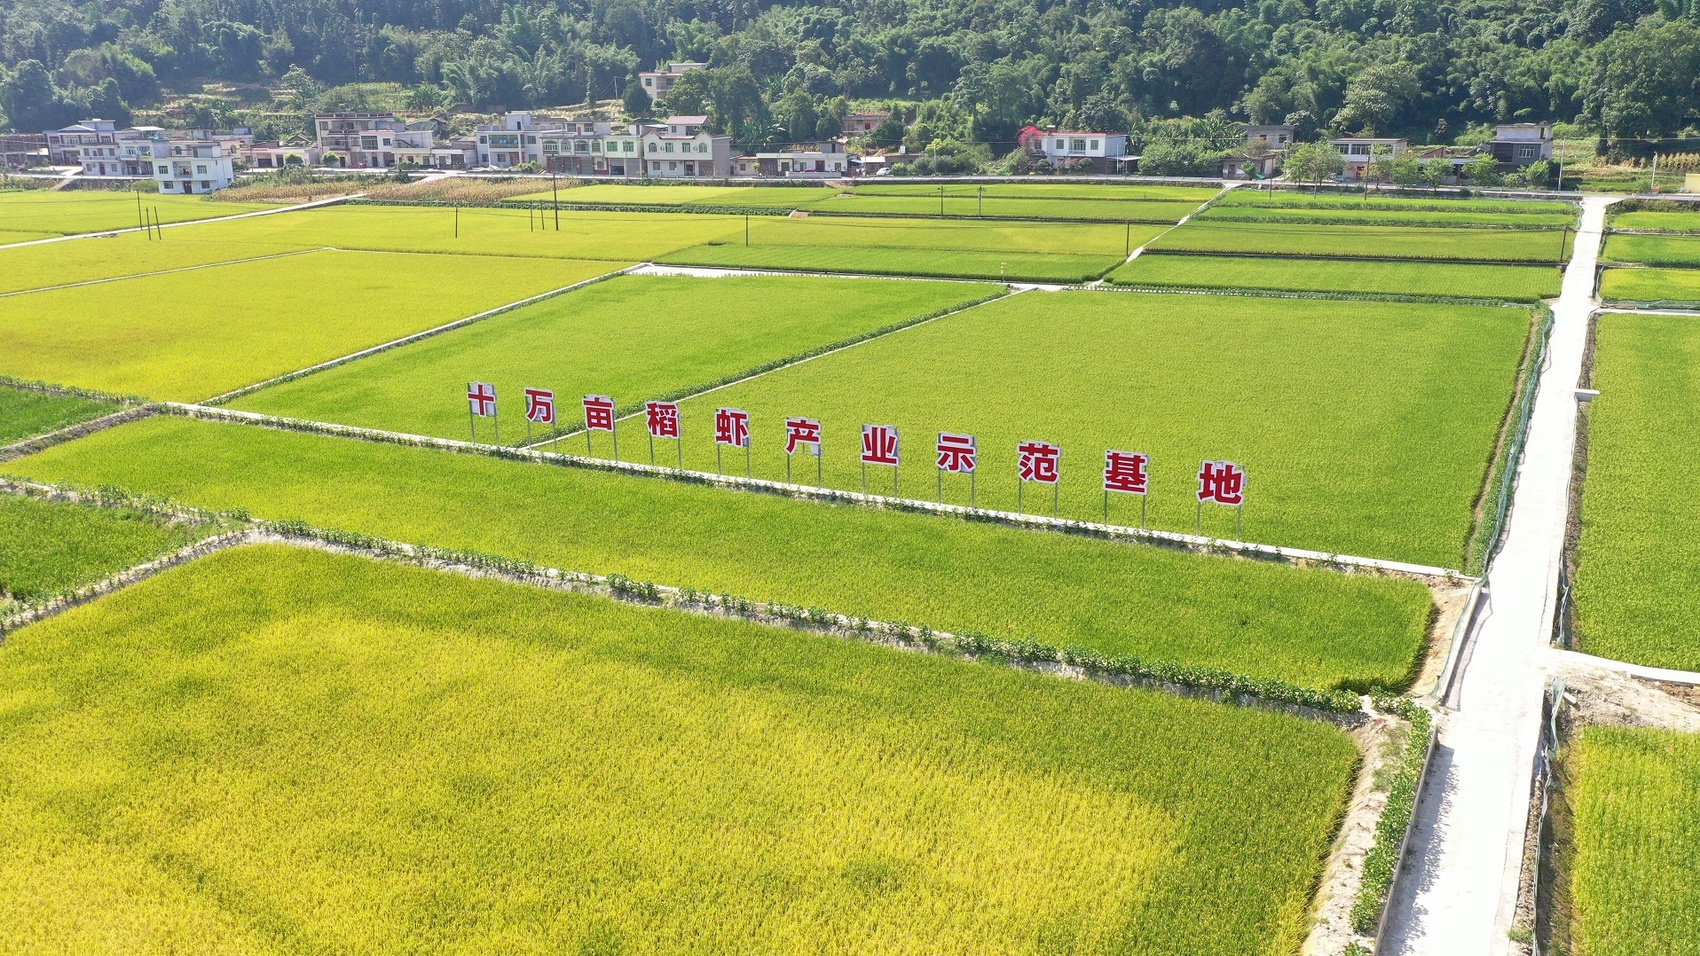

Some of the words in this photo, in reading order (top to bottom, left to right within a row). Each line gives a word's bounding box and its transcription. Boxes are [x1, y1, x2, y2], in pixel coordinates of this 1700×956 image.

[467, 384, 1243, 505] 十万亩稻虾产业示范基地
